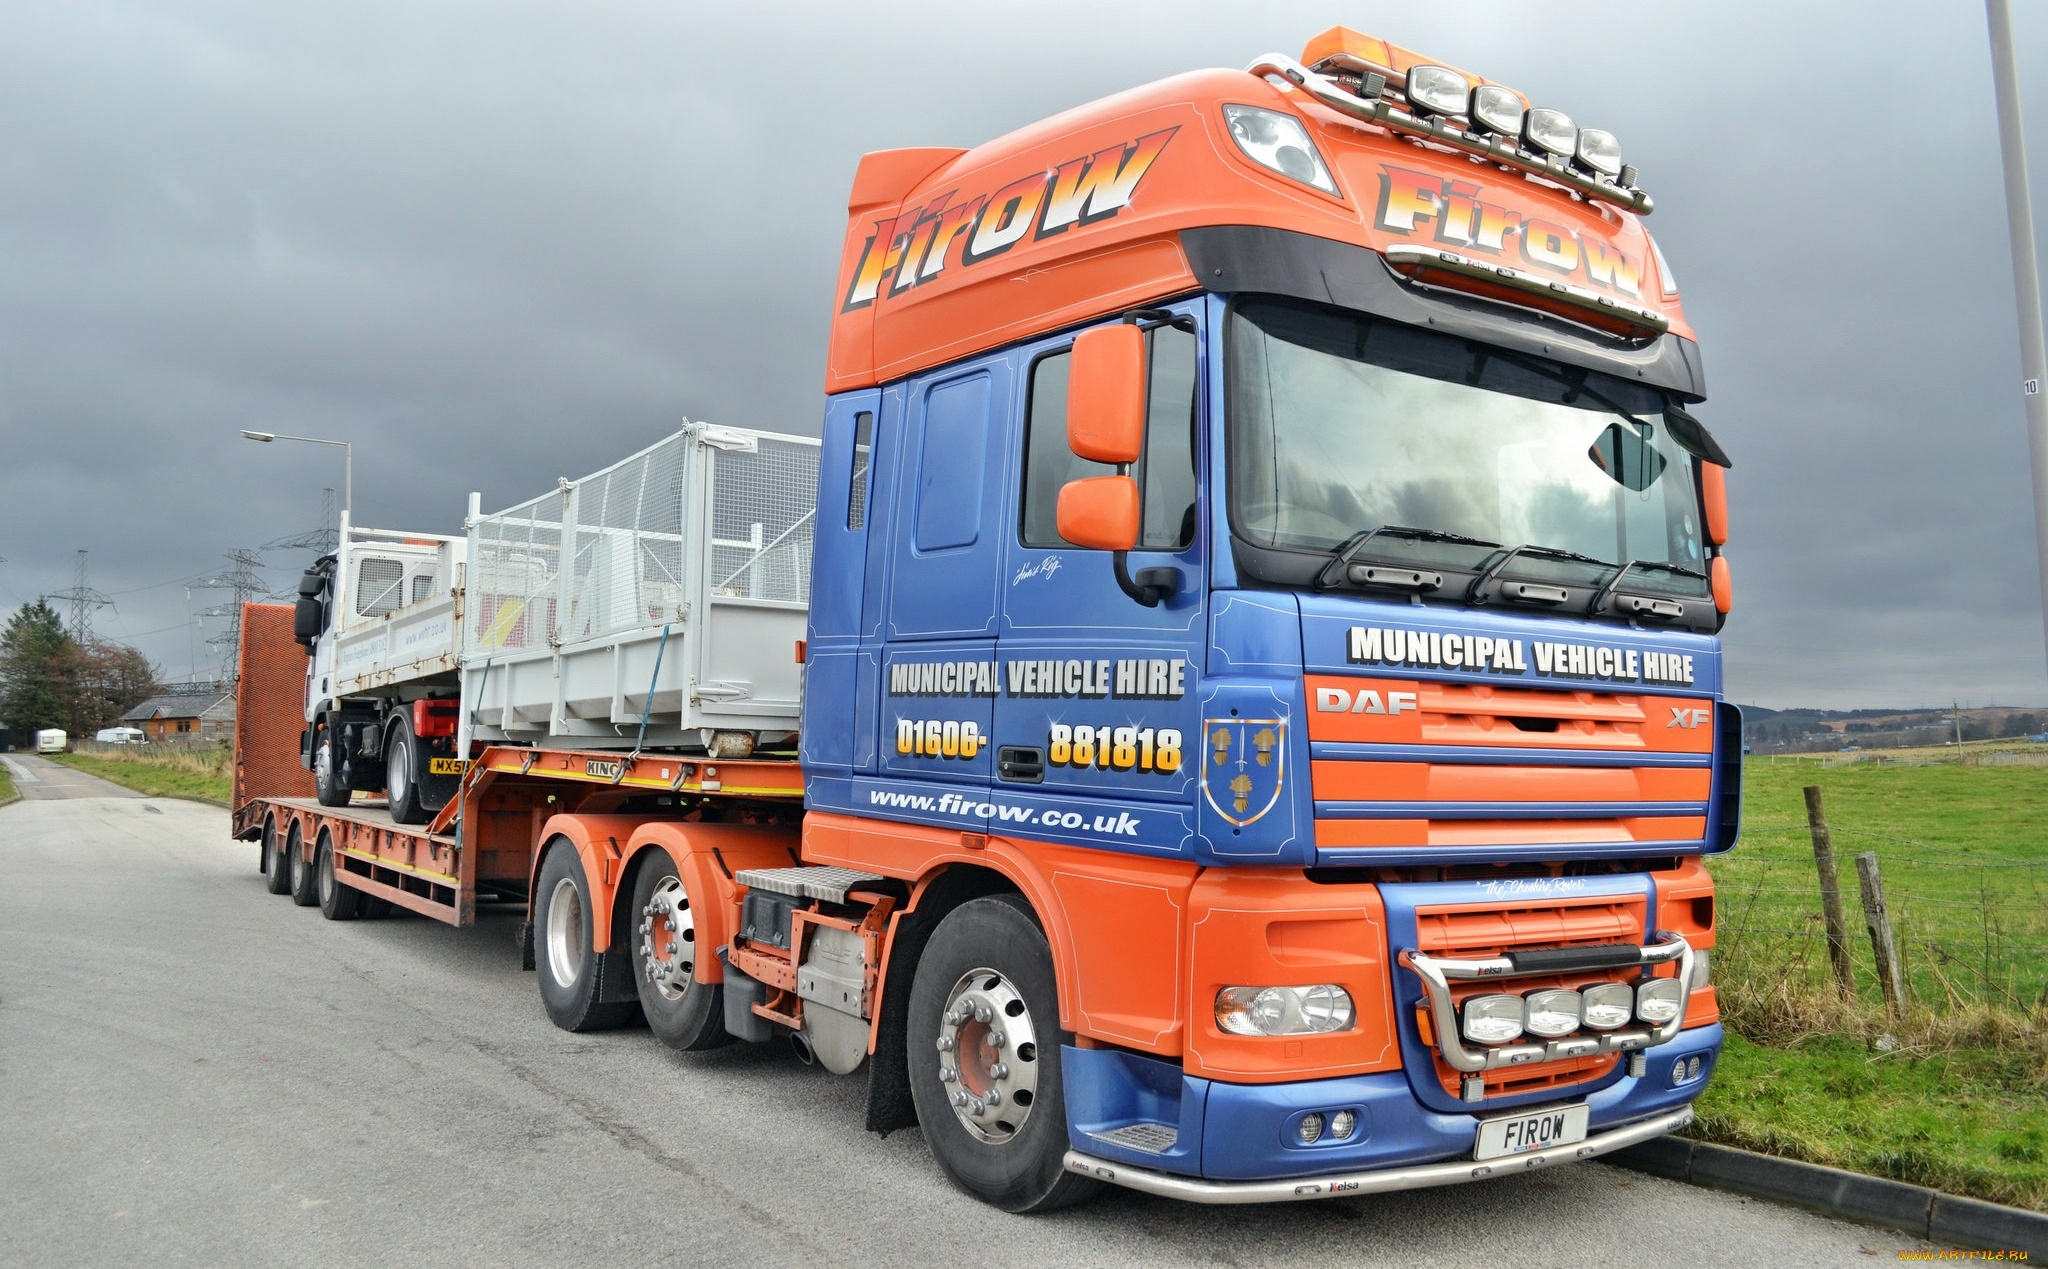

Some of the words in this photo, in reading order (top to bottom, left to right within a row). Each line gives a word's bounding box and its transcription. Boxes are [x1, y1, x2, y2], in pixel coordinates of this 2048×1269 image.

[2025, 380, 2037, 393] 10
[1347, 626, 1527, 672] MUNICIPAL
[1531, 641, 1638, 683] VEHICLE
[1642, 651, 1694, 687] HIRE
[889, 661, 1001, 698] MUNICIPAL
[1006, 660, 1110, 699] VEHICLE
[1112, 658, 1185, 701] HIRE
[1315, 687, 1417, 715] DAF
[1666, 707, 1709, 729] XF
[896, 718, 987, 760] 01606-
[1049, 724, 1183, 775] 881818
[870, 790, 1141, 836] www.firow.co.uk
[1477, 966, 1502, 976] Kelsa
[1504, 1113, 1565, 1148] FIROW
[1072, 1160, 1089, 1171] Kelsa
[1329, 1181, 1359, 1192] Kelsa
